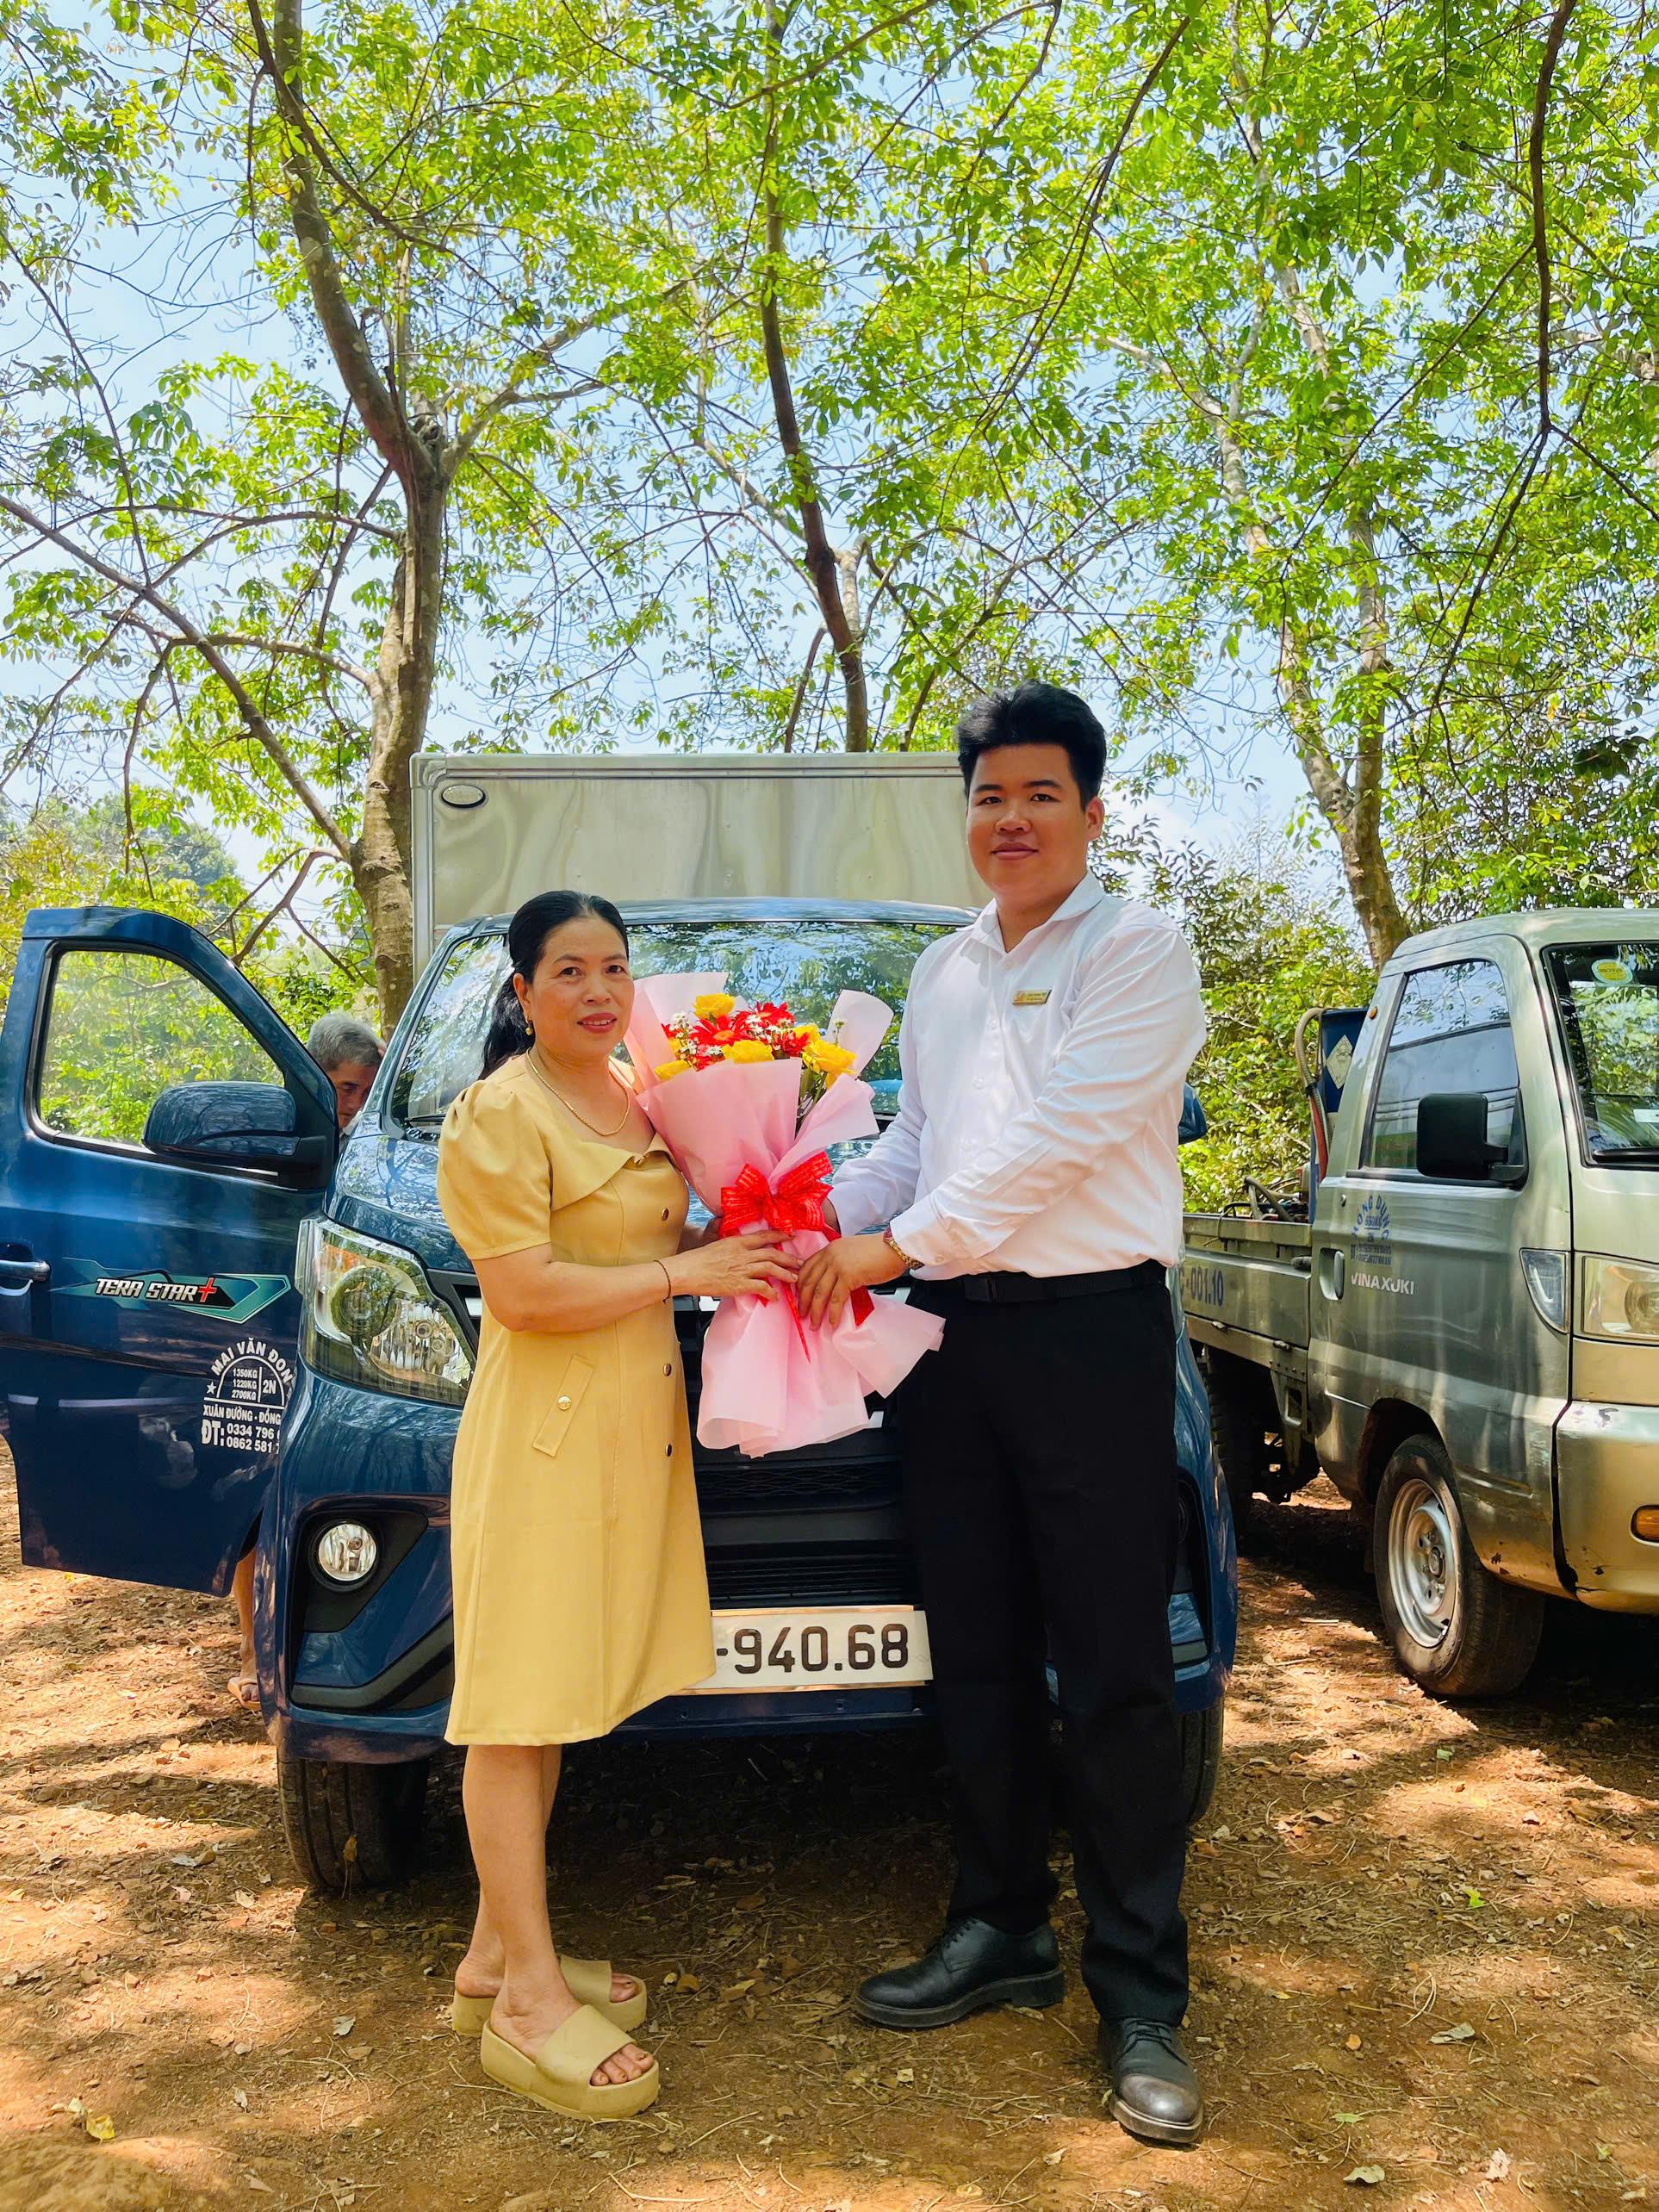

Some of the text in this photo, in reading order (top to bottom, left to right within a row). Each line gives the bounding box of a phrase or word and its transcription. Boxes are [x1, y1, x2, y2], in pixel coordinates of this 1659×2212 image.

[96, 1278, 144, 1297] TERA
[1351, 1272, 1414, 1295] VINAXUKI
[211, 1347, 235, 1376] MAI
[236, 1337, 267, 1357] VĂN
[262, 1379, 276, 1395] 2N
[227, 1422, 252, 1437] 0334
[255, 1426, 275, 1440] 796
[226, 1436, 252, 1451] 0862
[254, 1439, 272, 1454] 581
